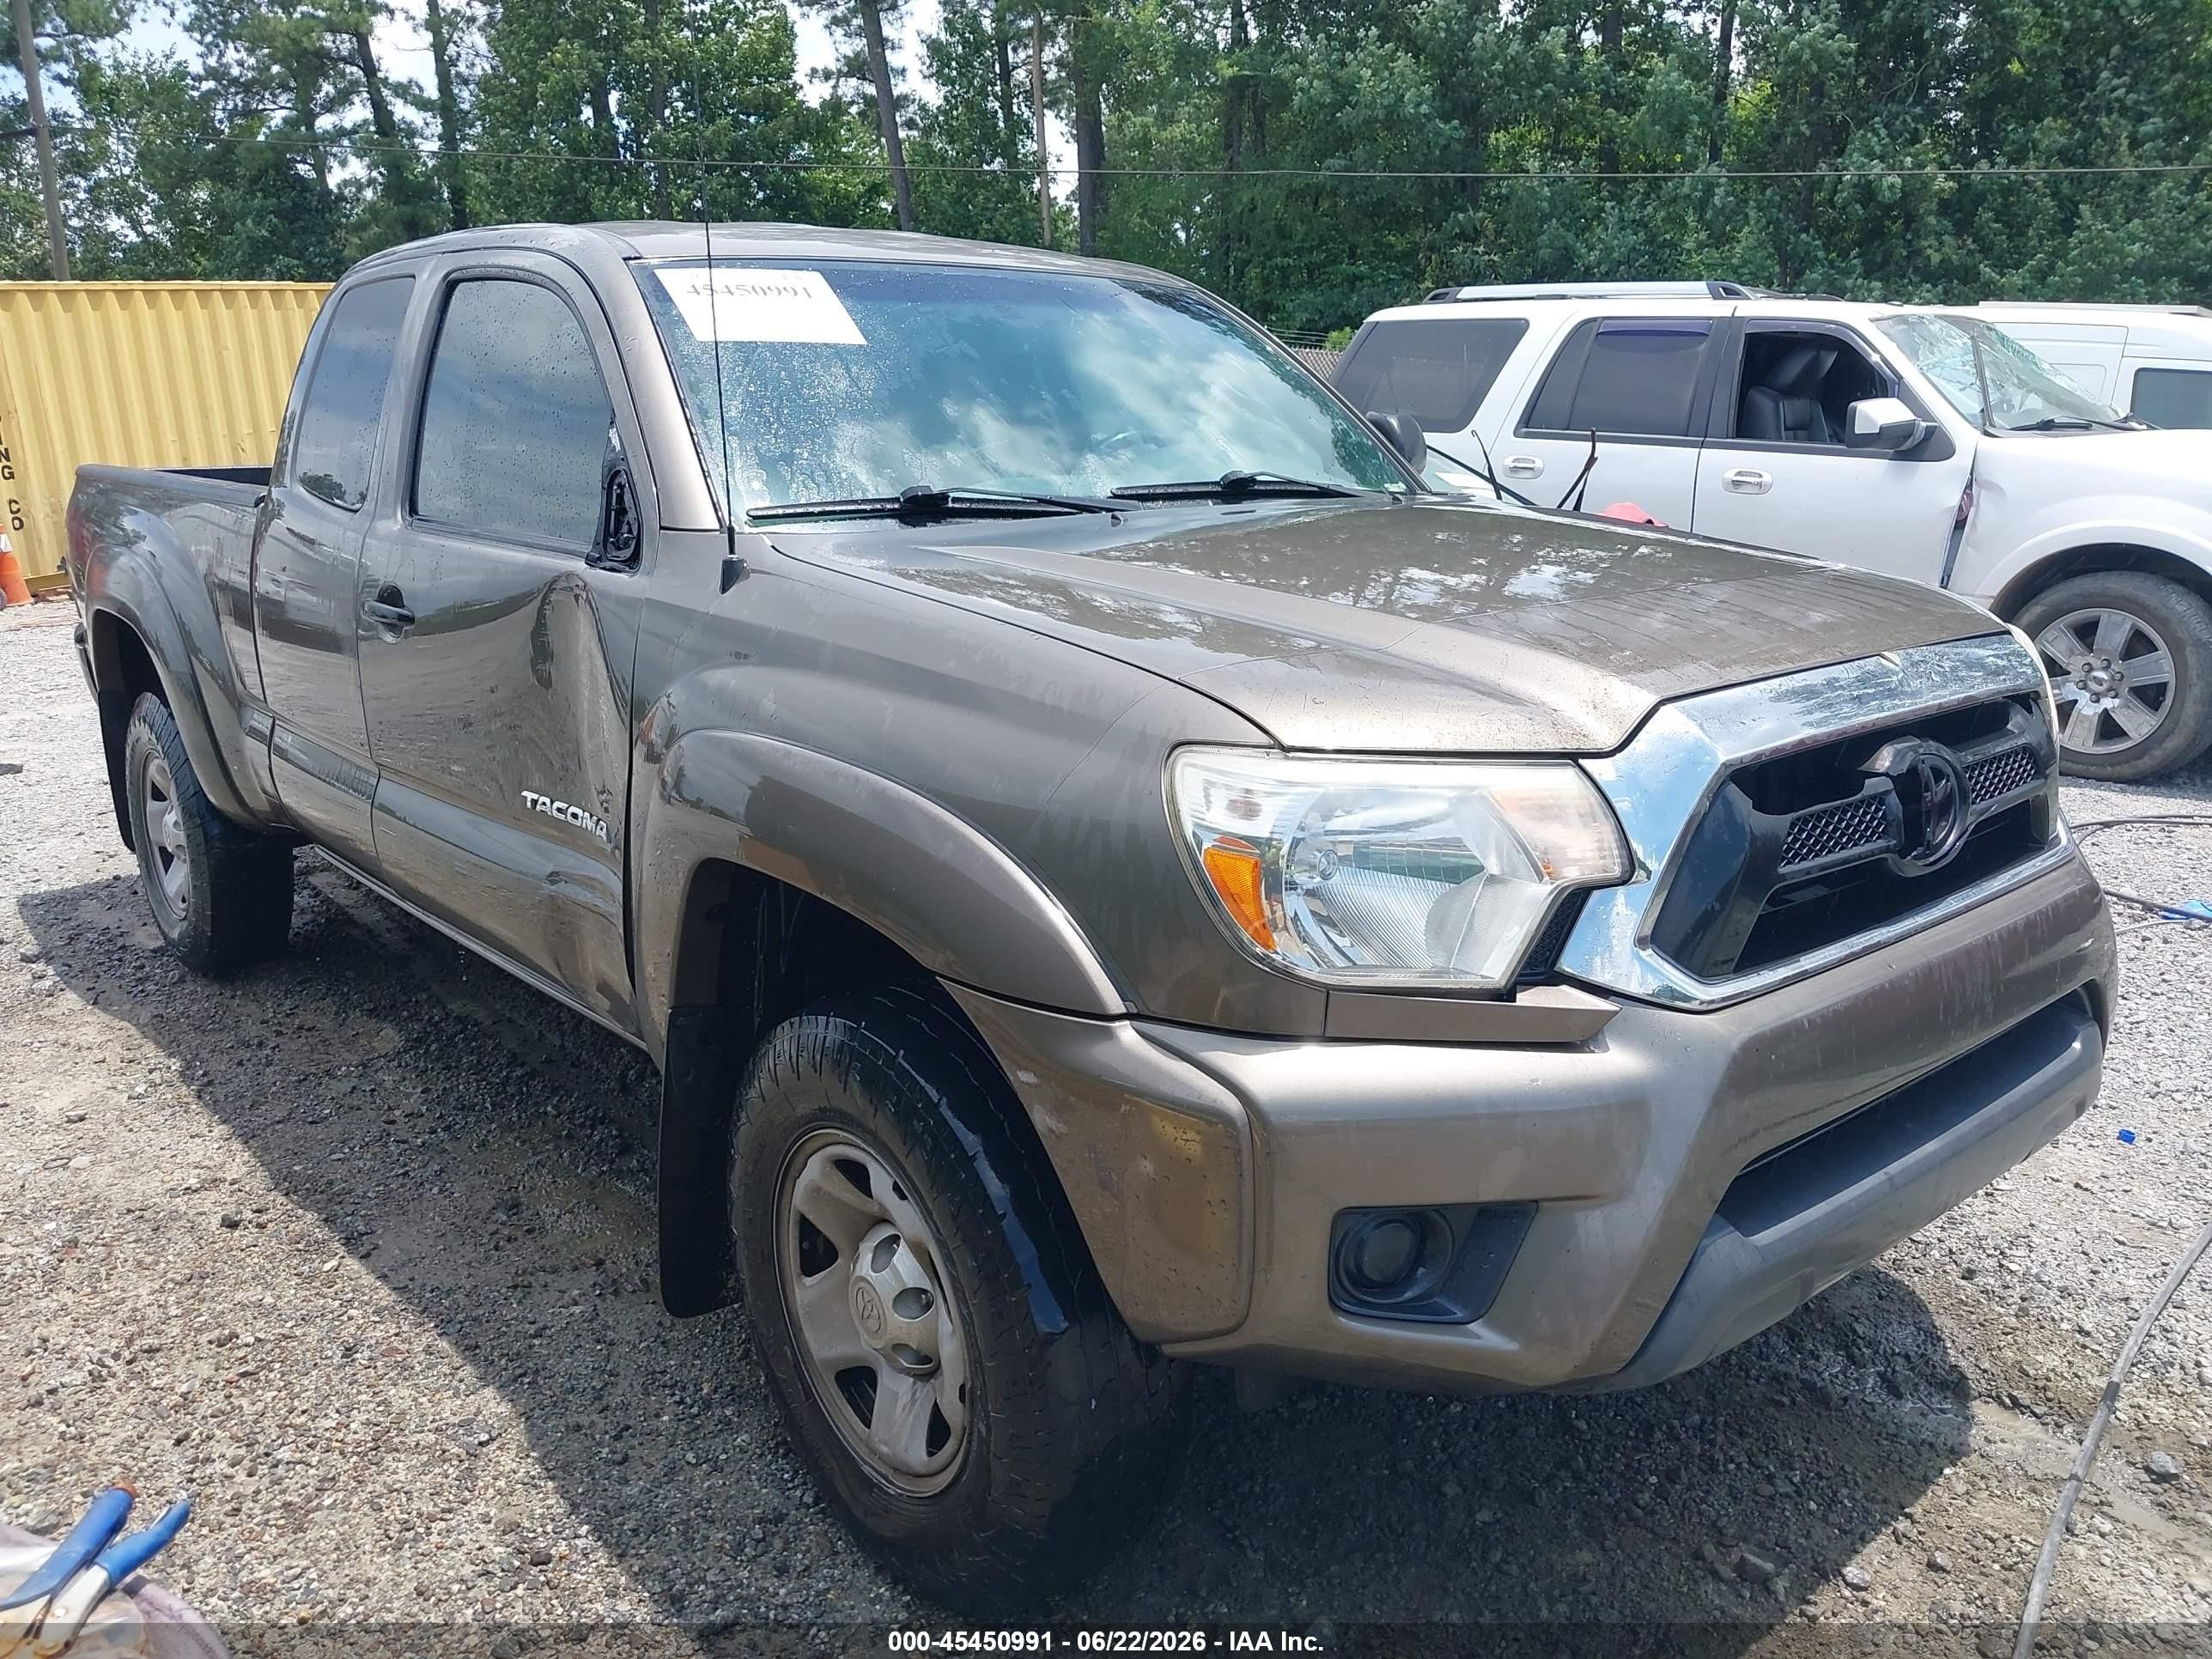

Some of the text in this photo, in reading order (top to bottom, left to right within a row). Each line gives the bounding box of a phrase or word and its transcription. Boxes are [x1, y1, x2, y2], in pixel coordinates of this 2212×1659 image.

[686, 283, 813, 299] 45450991
[9, 498, 25, 532] CO
[520, 790, 610, 843] TACOMA
